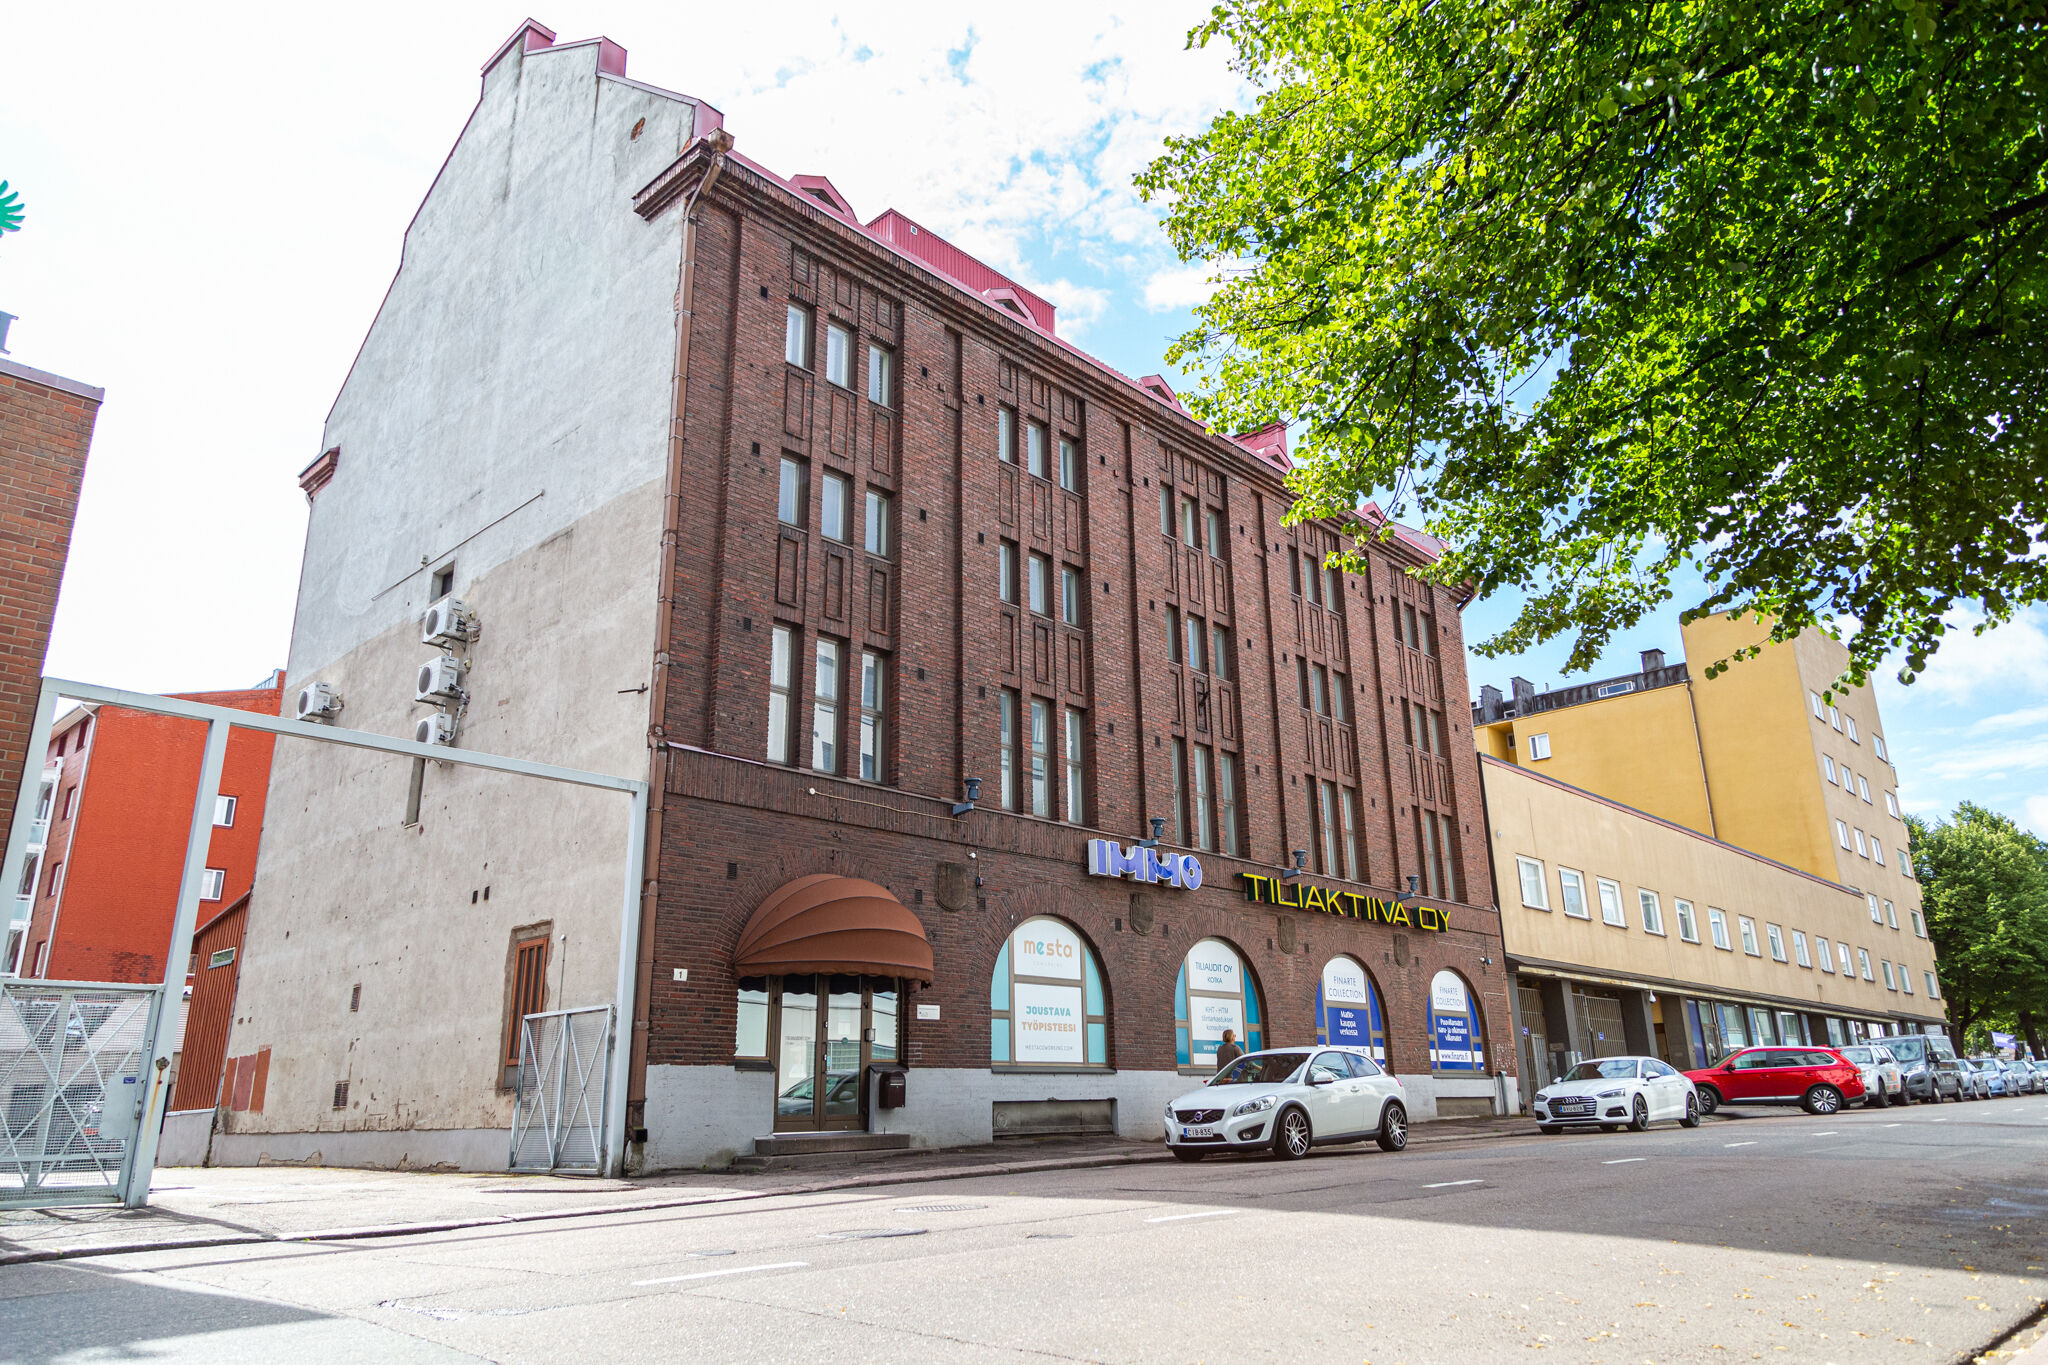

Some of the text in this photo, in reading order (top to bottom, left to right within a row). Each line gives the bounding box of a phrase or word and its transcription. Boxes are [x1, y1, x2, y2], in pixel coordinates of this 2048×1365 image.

[1088, 839, 1202, 890] IMMO
[1242, 873, 1451, 932] TILIAKTIIVA OY
[1023, 938, 1073, 959] mesta
[1223, 964, 1233, 973] OY
[1207, 976, 1223, 984] KOTKA
[1333, 975, 1356, 986] FINARTE
[1328, 987, 1364, 999] COLLECTION
[1439, 986, 1458, 996] FINARTE
[1025, 1005, 1071, 1017] JOUSTAVA
[1021, 1019, 1077, 1032] TYÖPISTEESI
